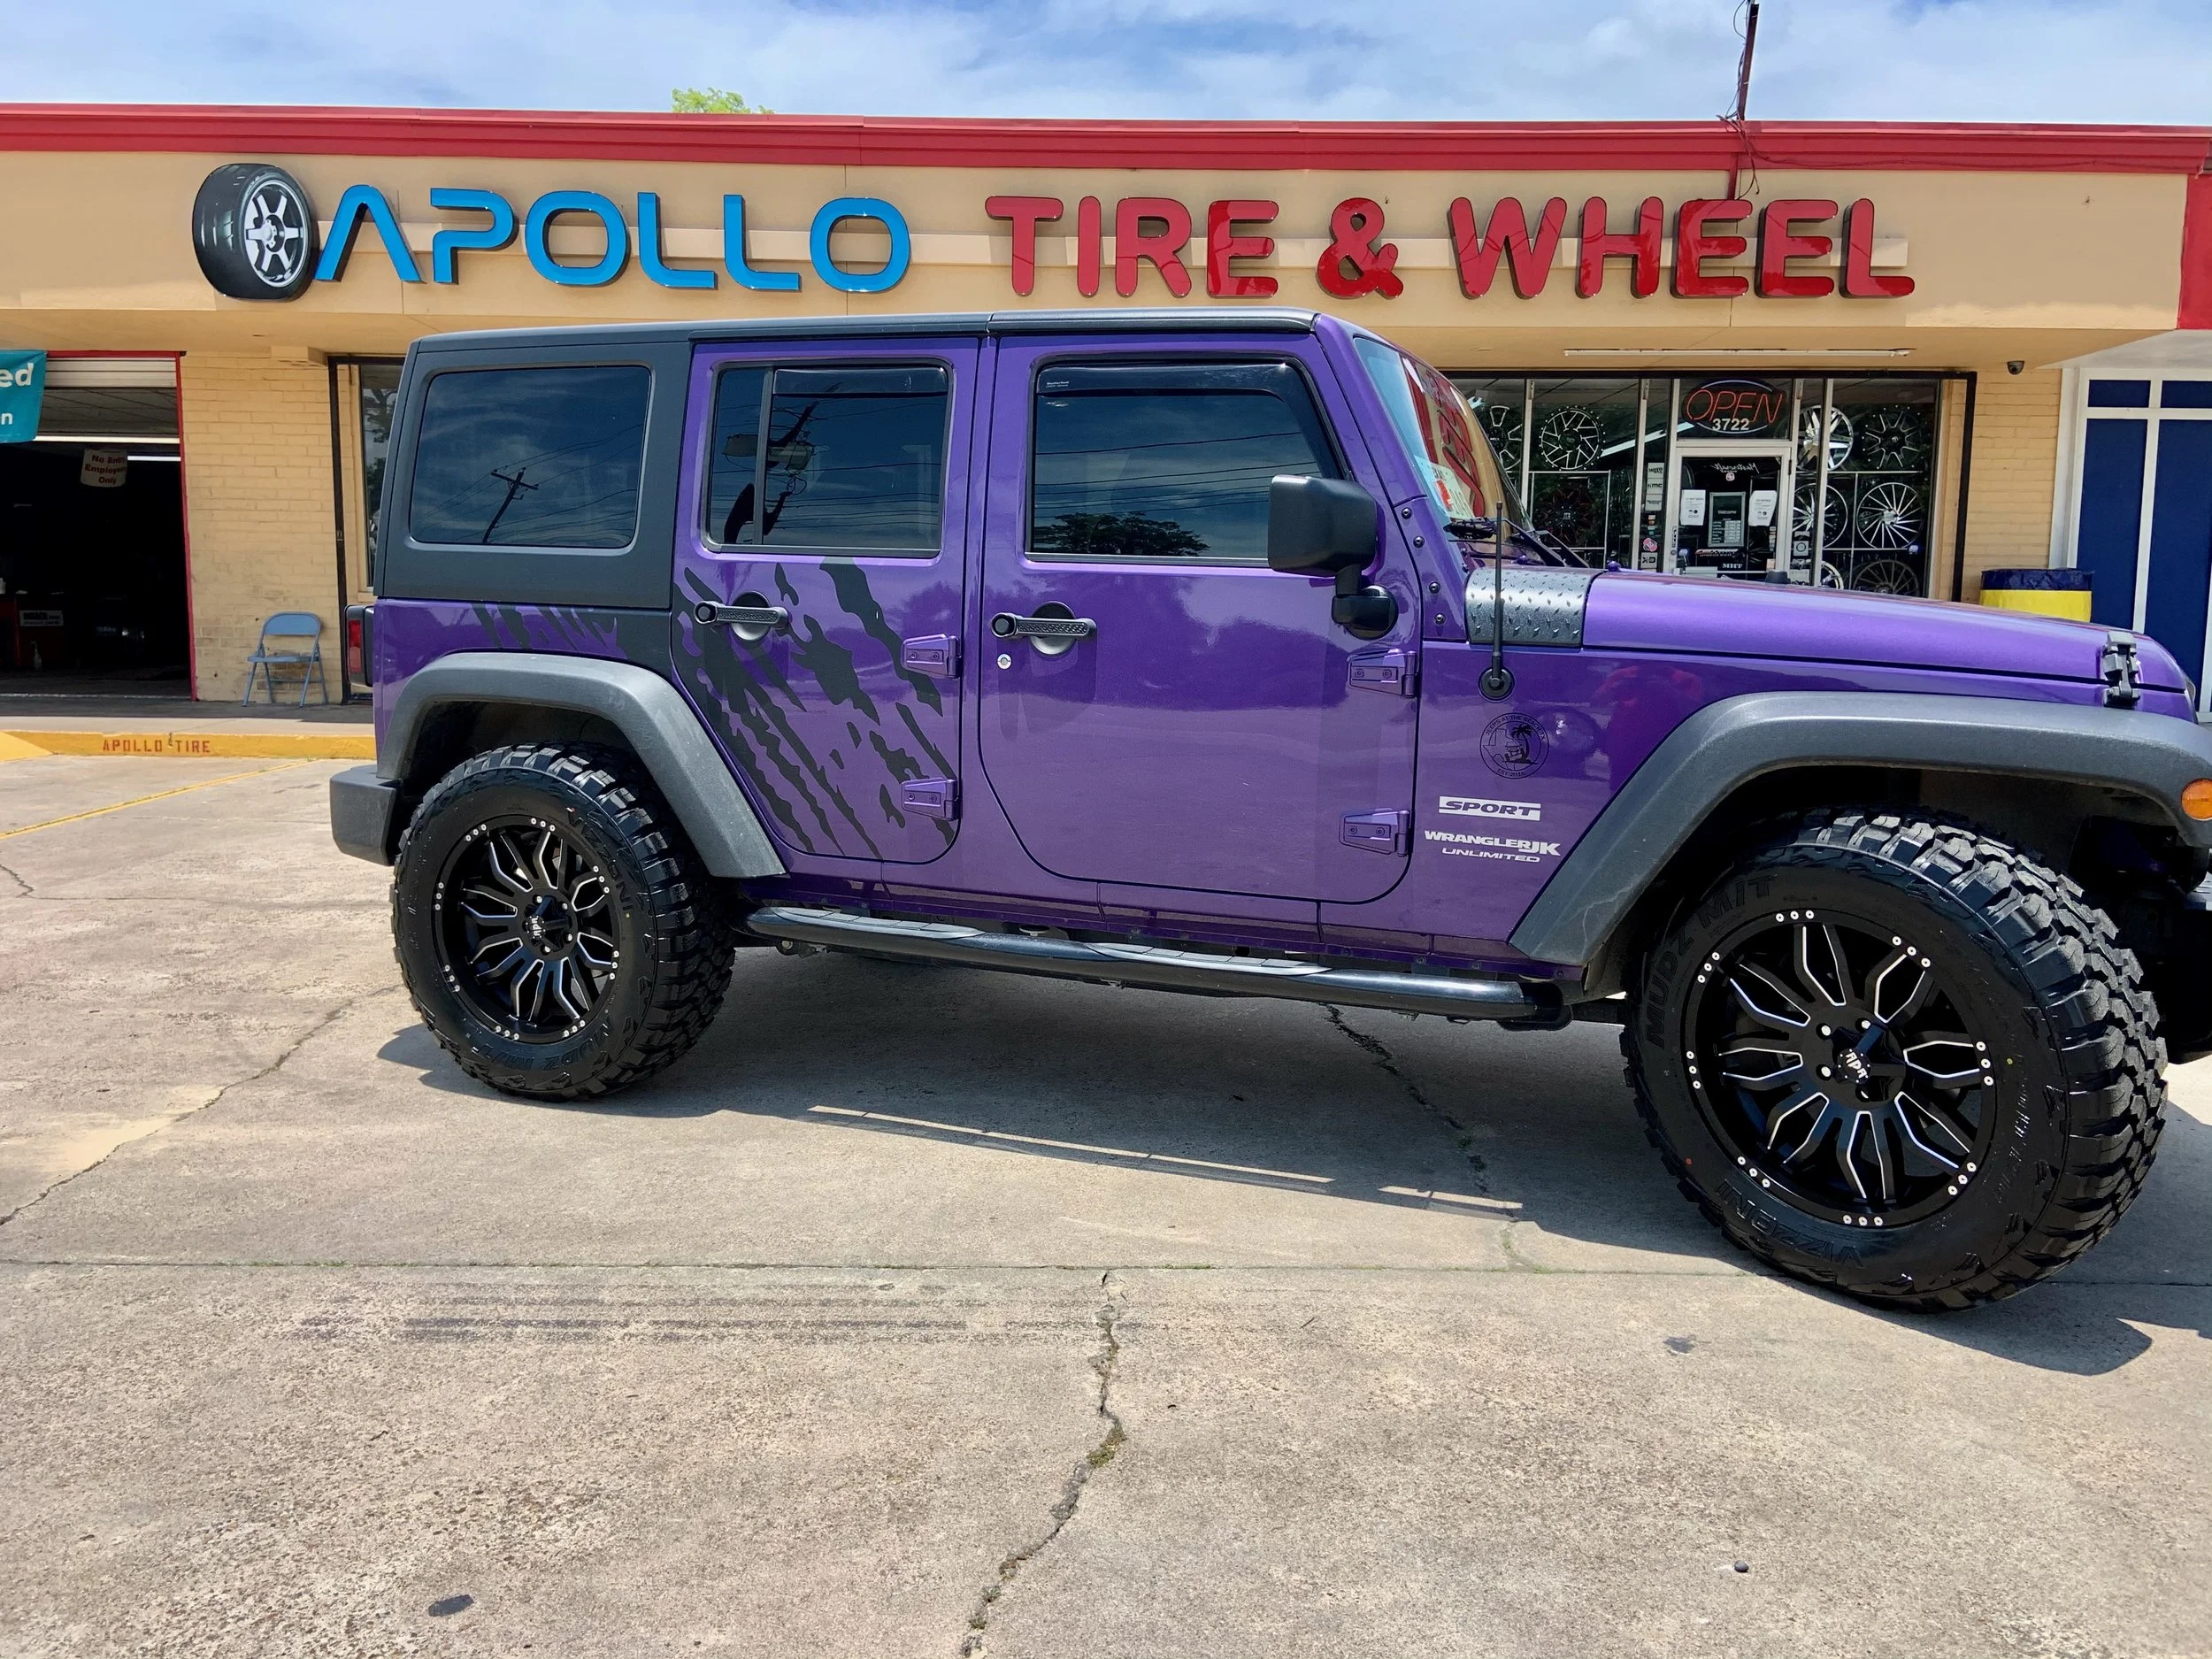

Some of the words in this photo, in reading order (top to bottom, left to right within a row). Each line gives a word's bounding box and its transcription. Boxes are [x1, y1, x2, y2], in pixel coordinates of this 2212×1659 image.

[315, 184, 910, 293] APOLLO
[985, 196, 1279, 297] TIRE
[1317, 197, 1403, 299] &
[1448, 196, 1916, 298] WHEEL
[1686, 389, 1782, 424] OPEN
[1712, 418, 1750, 431] 3722
[98, 476, 117, 485] Only
[103, 740, 163, 752] APOLLO
[175, 740, 211, 753] TIRE
[1445, 800, 1540, 817] SPORT
[1441, 848, 1540, 863] UNLIMITED
[1645, 929, 1694, 1049] MUDZ
